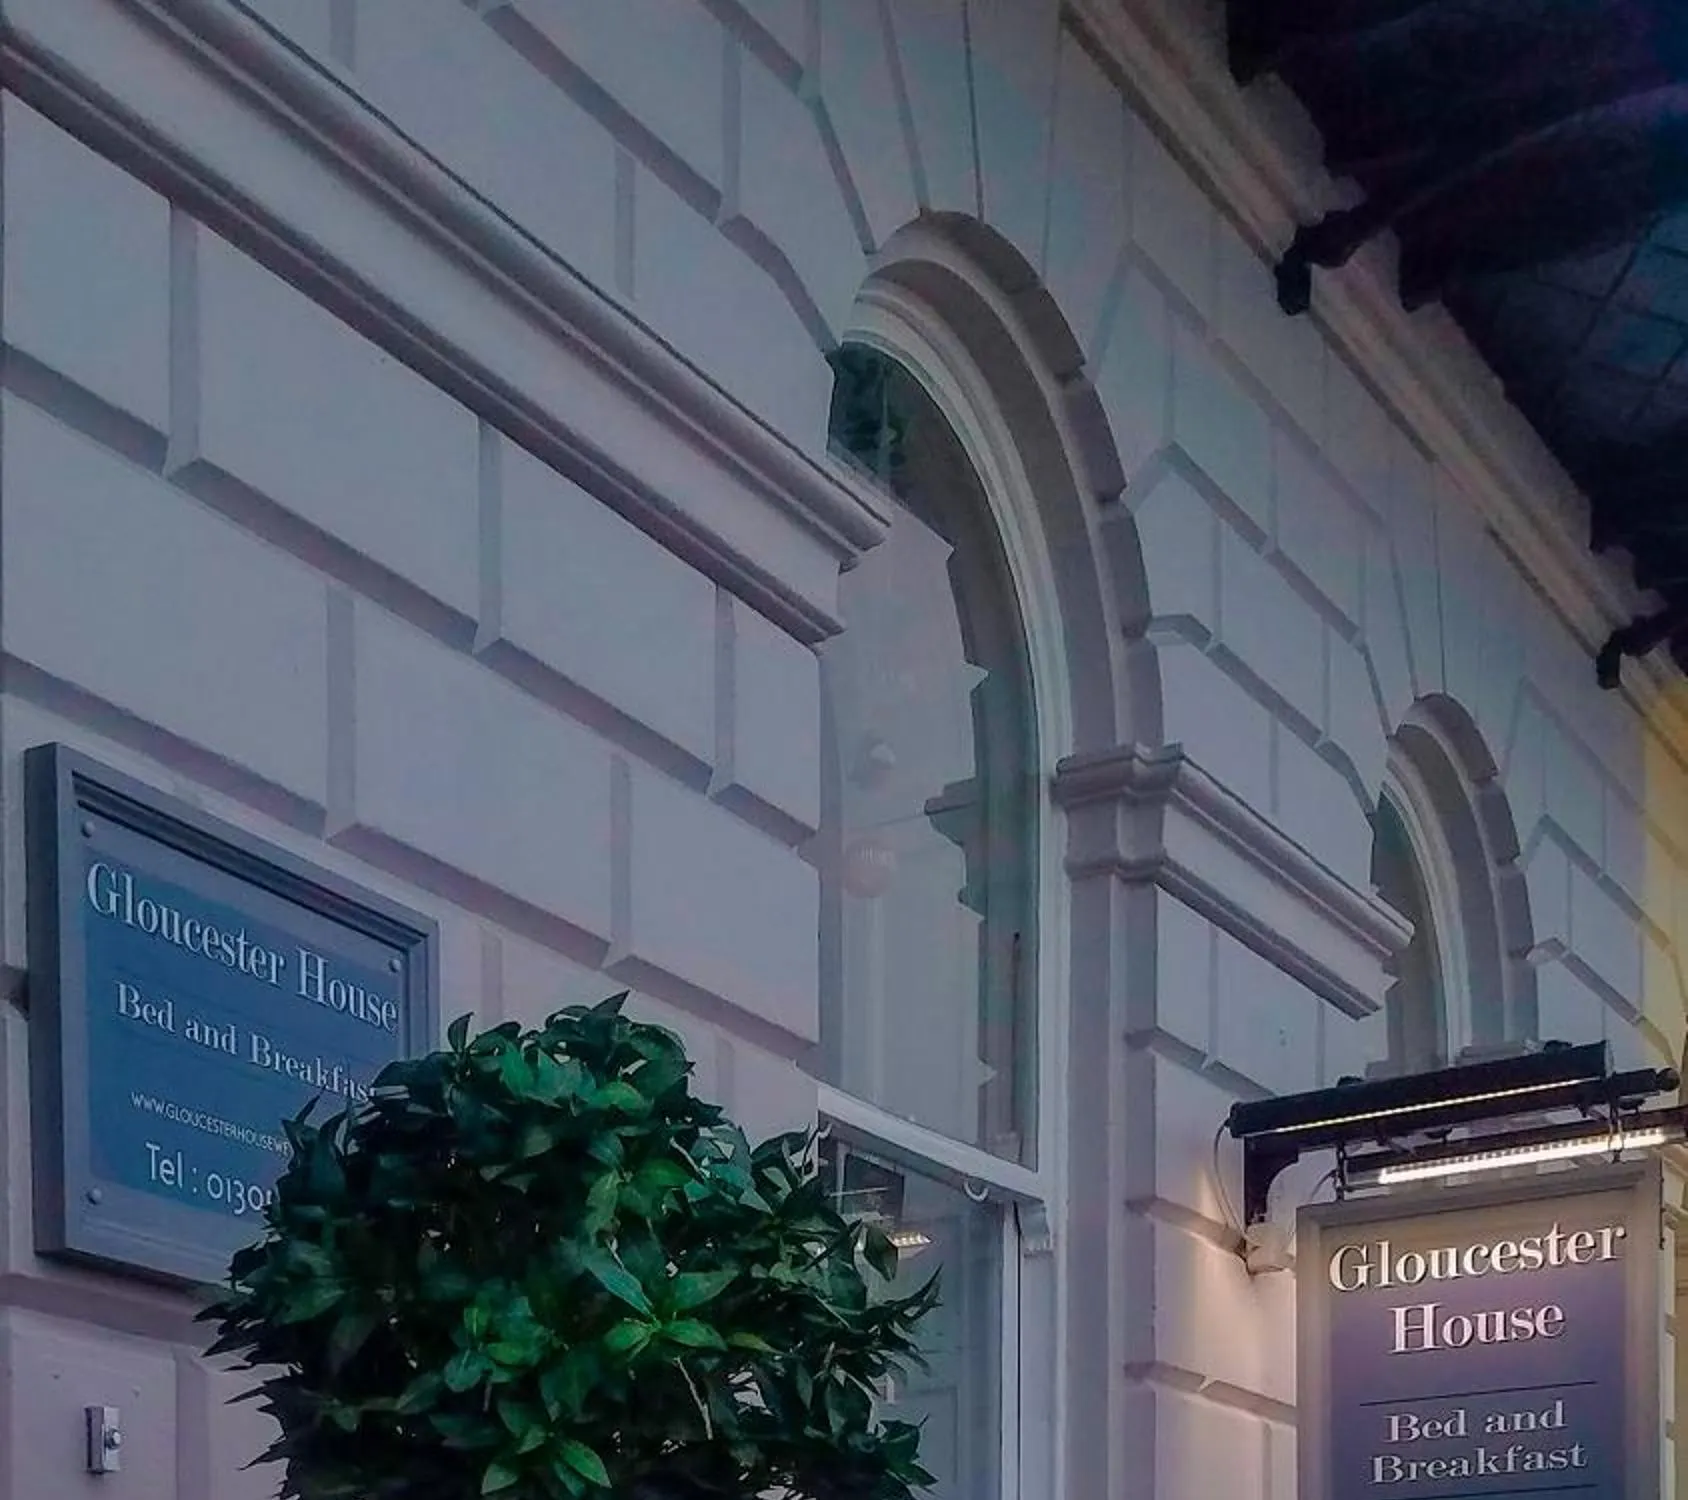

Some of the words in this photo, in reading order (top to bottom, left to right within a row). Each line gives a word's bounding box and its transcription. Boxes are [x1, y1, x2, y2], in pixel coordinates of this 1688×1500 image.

[86, 861, 285, 987] Gloucester
[296, 946, 399, 1037] House
[115, 983, 176, 1035] Bed
[184, 1015, 238, 1056] and
[145, 1141, 184, 1189] Tel
[1329, 1223, 1627, 1291] Gloucester
[1388, 1303, 1566, 1354] House
[1385, 1409, 1466, 1442] Bed
[1484, 1399, 1567, 1431] and
[1369, 1443, 1588, 1484] Breakfast
